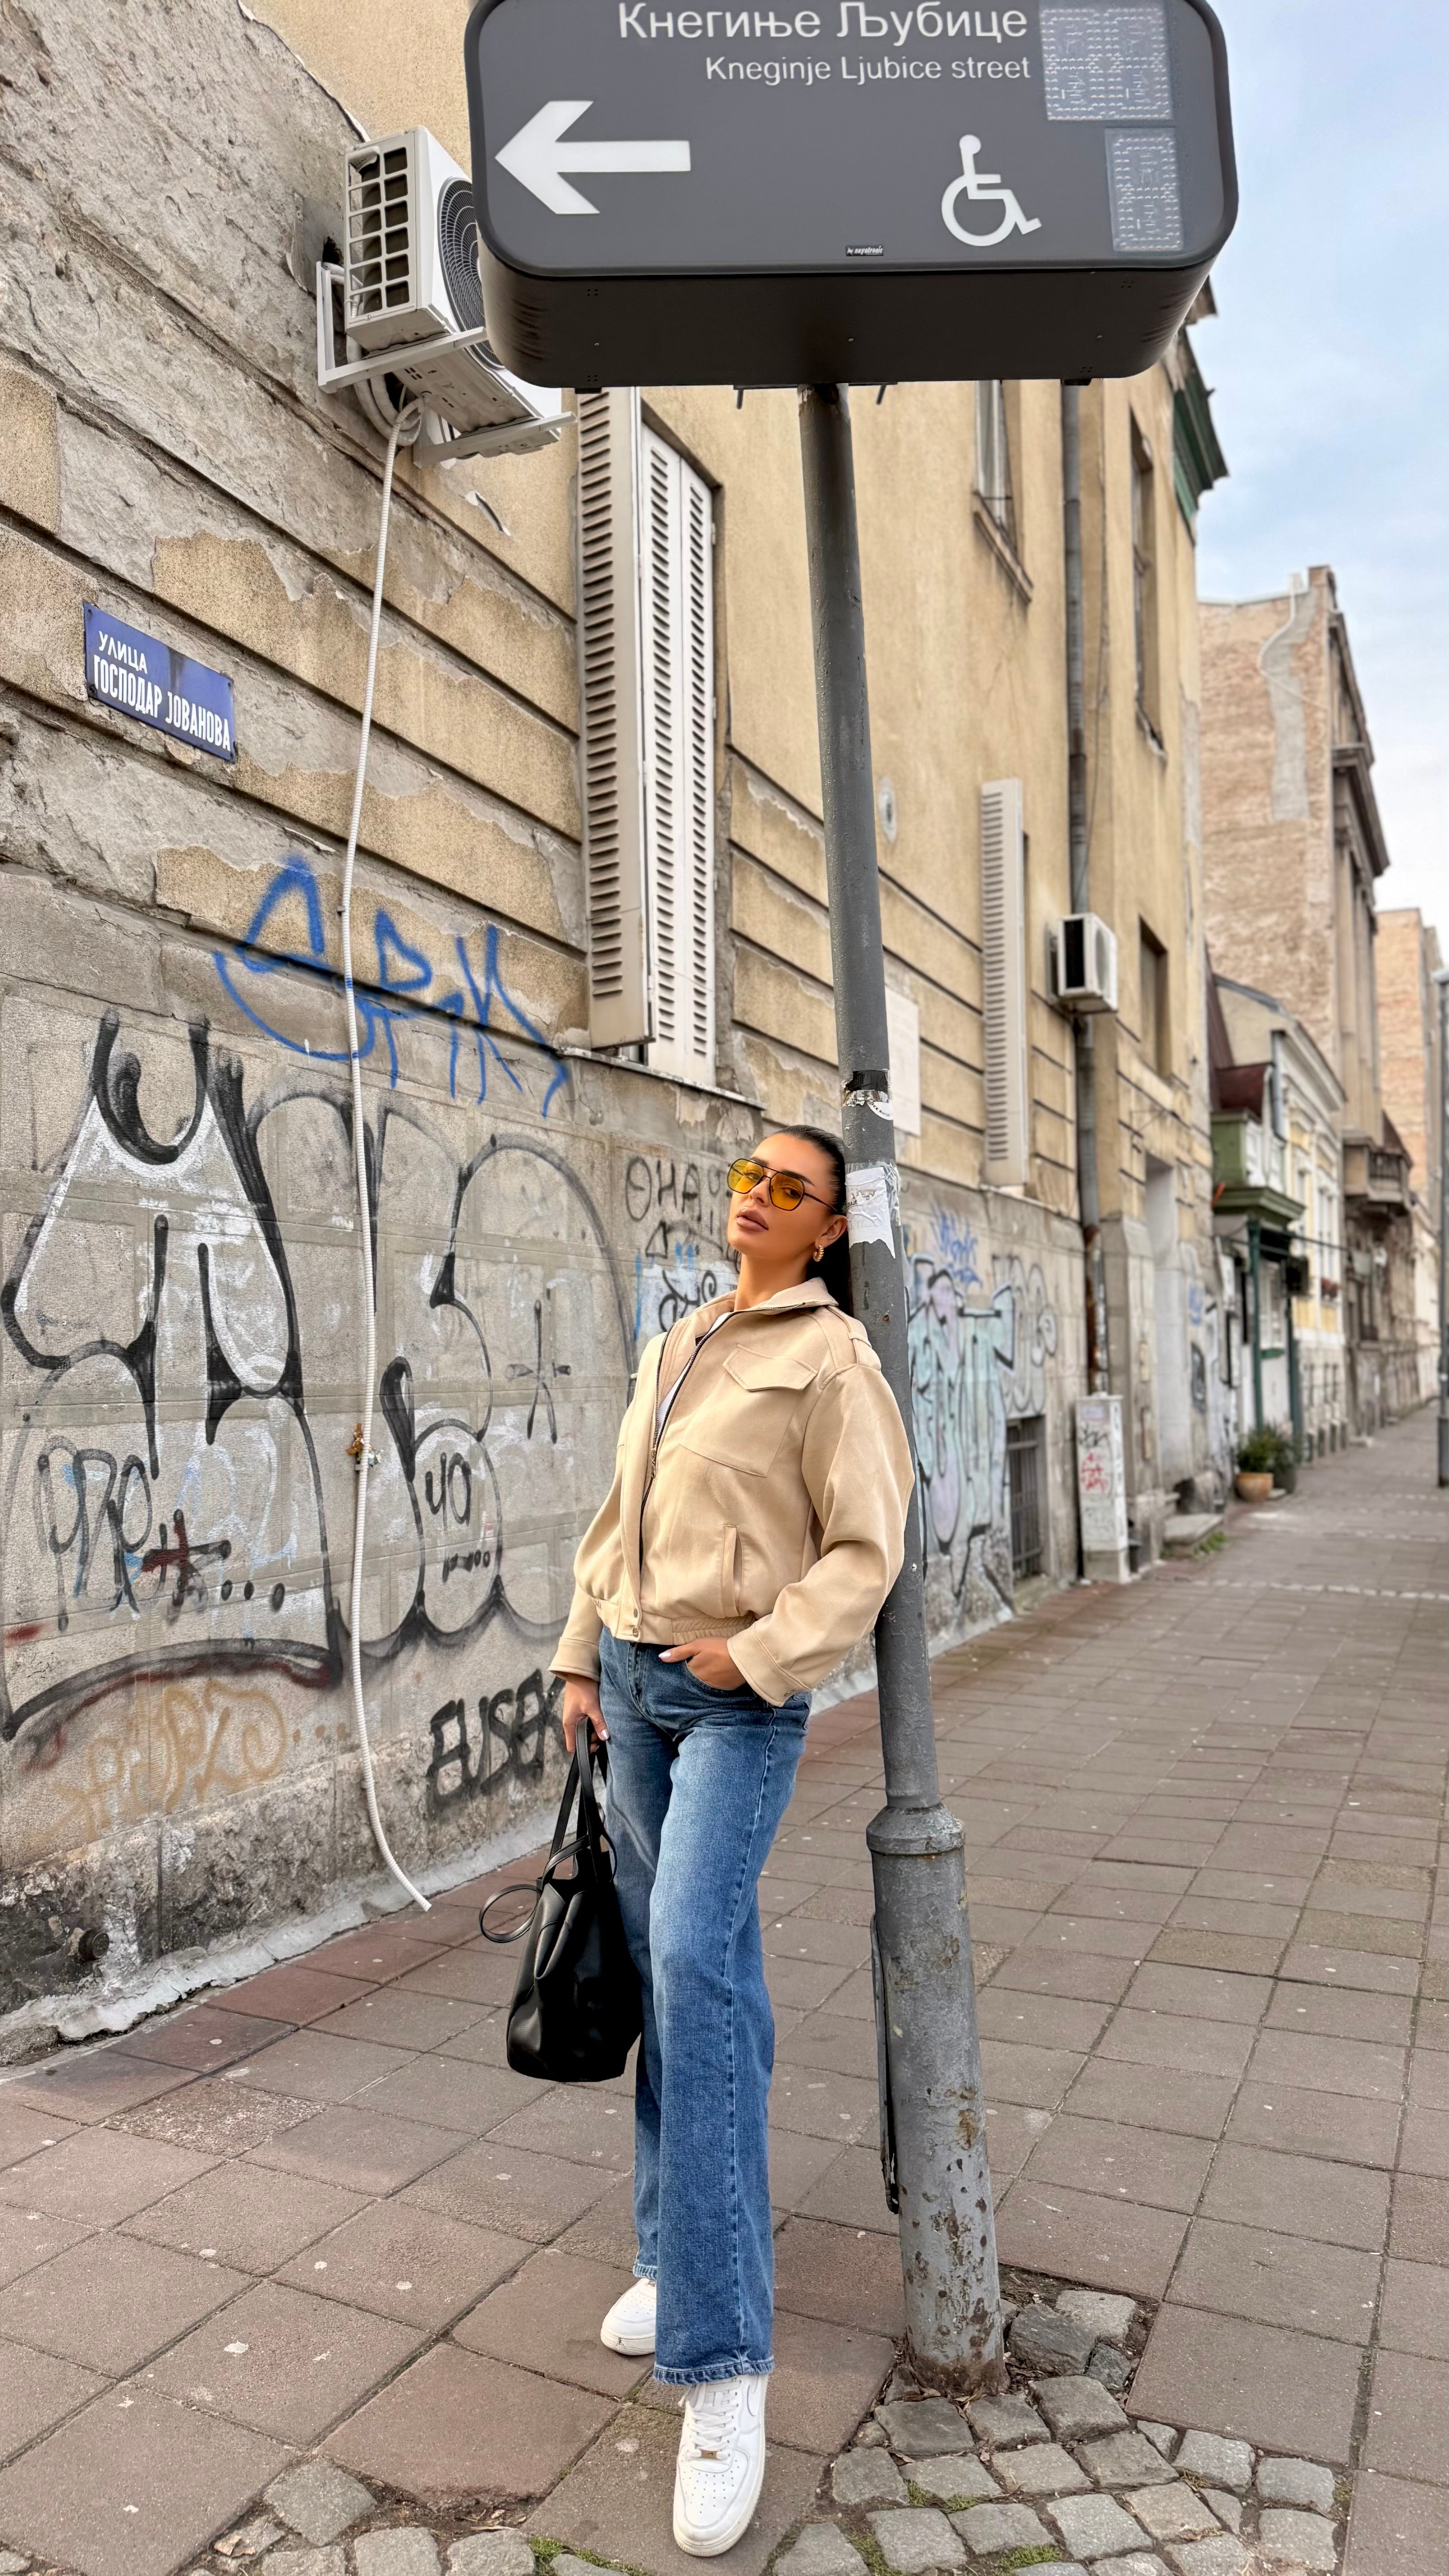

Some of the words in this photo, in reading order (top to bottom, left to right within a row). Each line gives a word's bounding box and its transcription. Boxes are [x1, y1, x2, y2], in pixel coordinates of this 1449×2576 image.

[619, 2, 821, 38] Кнегиње
[836, 1, 1027, 46] Љубице
[706, 56, 831, 86] Kneginje
[841, 56, 942, 85] Ljubice
[951, 56, 1031, 79] street
[98, 630, 148, 675] УЛИЦА
[93, 654, 162, 718] ГОСПОДАР
[165, 691, 231, 752] ЈОВАНОВА
